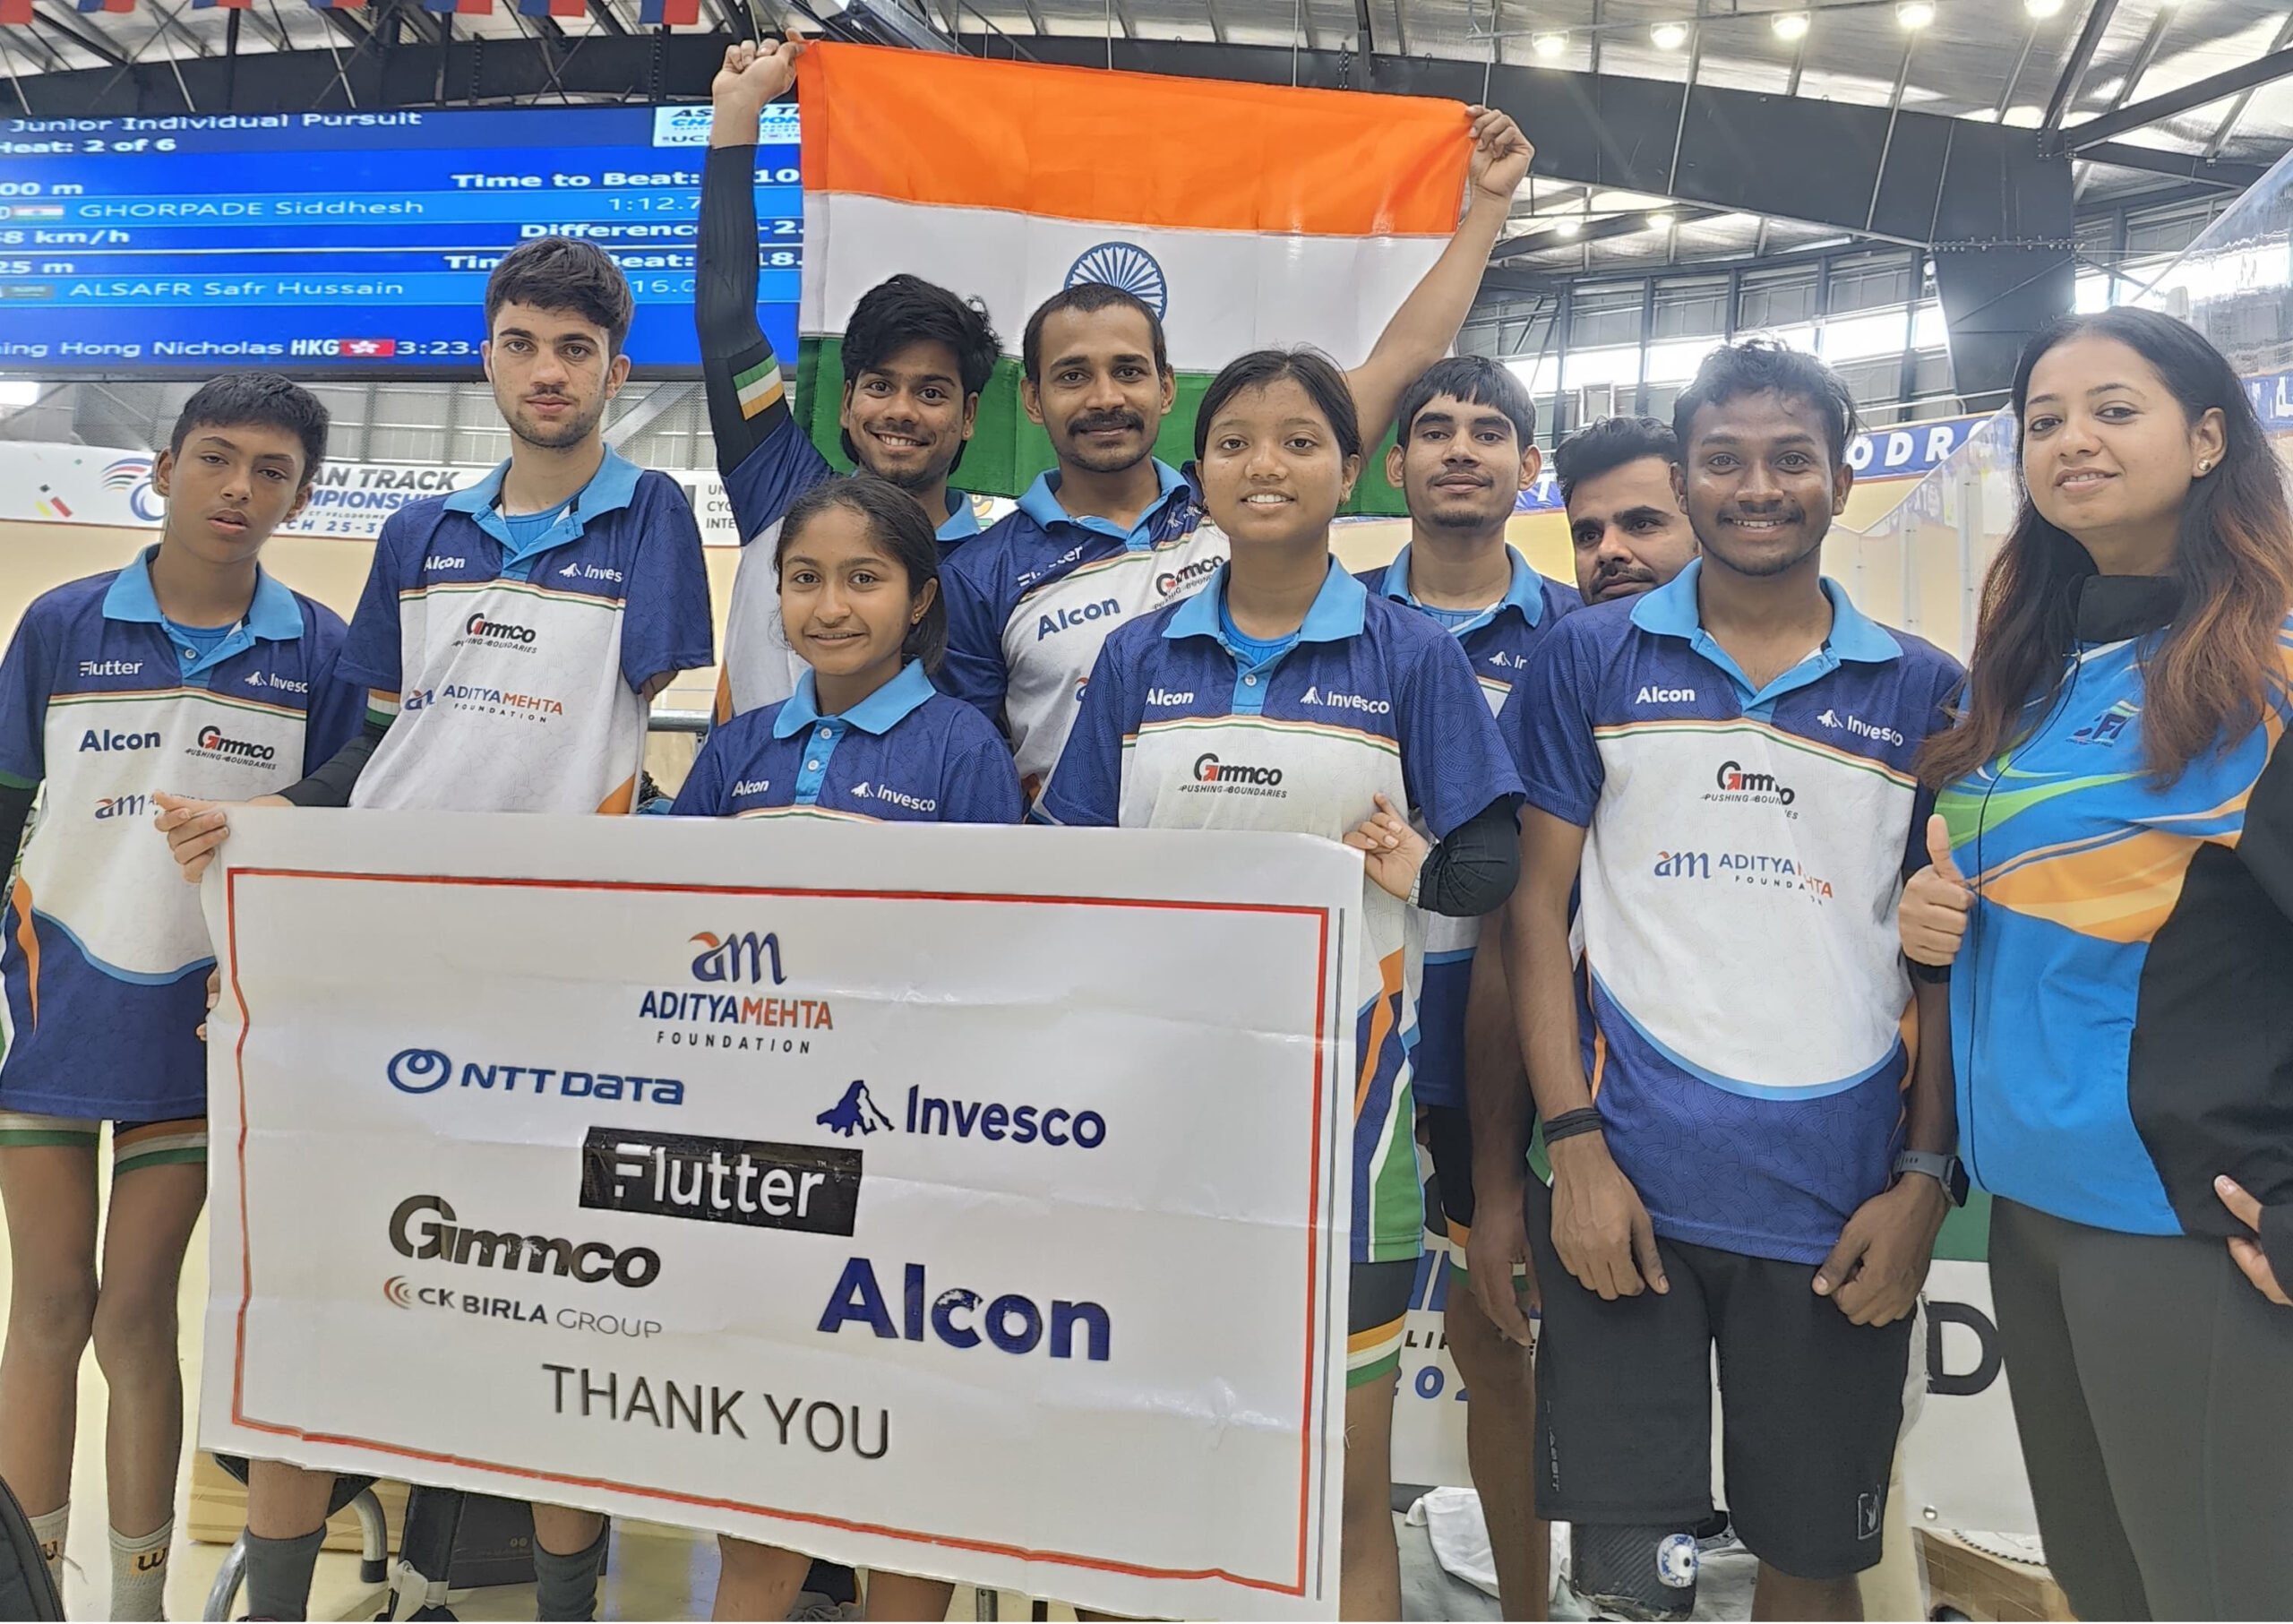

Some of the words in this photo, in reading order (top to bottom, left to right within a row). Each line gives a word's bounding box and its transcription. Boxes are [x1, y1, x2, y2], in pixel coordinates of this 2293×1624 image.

[8, 118, 113, 133] Junior
[122, 113, 288, 131] Individual
[302, 111, 422, 127] Pursuit
[84, 139, 106, 153] 2
[111, 138, 148, 152] of
[155, 138, 176, 151] 6
[52, 184, 84, 195] m
[451, 175, 548, 188] Time
[553, 174, 591, 188] to
[602, 171, 701, 187] Beat:
[79, 202, 263, 219] GHORPADE
[275, 201, 425, 215] Siddhesh
[35, 228, 130, 245] km/h
[520, 224, 699, 238] Differenc
[43, 262, 74, 273] m
[69, 283, 193, 296] ALSAFR
[203, 281, 265, 296] Safr
[277, 279, 404, 295] Hussain
[60, 340, 141, 357] Hong
[153, 340, 284, 355] Nicholas
[291, 339, 340, 356] HKG
[359, 469, 460, 490] TRACK
[1037, 596, 1121, 641] Alcon
[80, 660, 143, 677] Flutter
[1146, 689, 1194, 706] Alcon
[1327, 691, 1391, 715] Invesco
[1636, 686, 1696, 705] Alcon
[453, 702, 548, 723] FOUNDATION
[79, 730, 160, 752] Alcon
[731, 780, 769, 797] Alcon
[877, 785, 936, 812] Invesco
[1179, 785, 1223, 795] PUSHING
[1224, 786, 1288, 799] BOUNDARIES
[657, 1031, 811, 1054] FOUNDATION
[460, 1063, 556, 1094] NTT
[906, 1084, 1106, 1149] Invesco
[614, 1142, 826, 1218] Flutter
[417, 1288, 455, 1309] CK
[462, 1295, 548, 1325] BIRLA
[556, 1309, 663, 1339] GROUP
[818, 1257, 1112, 1362] Alcon
[542, 1363, 748, 1440] THANK
[763, 1394, 889, 1460] YOU
